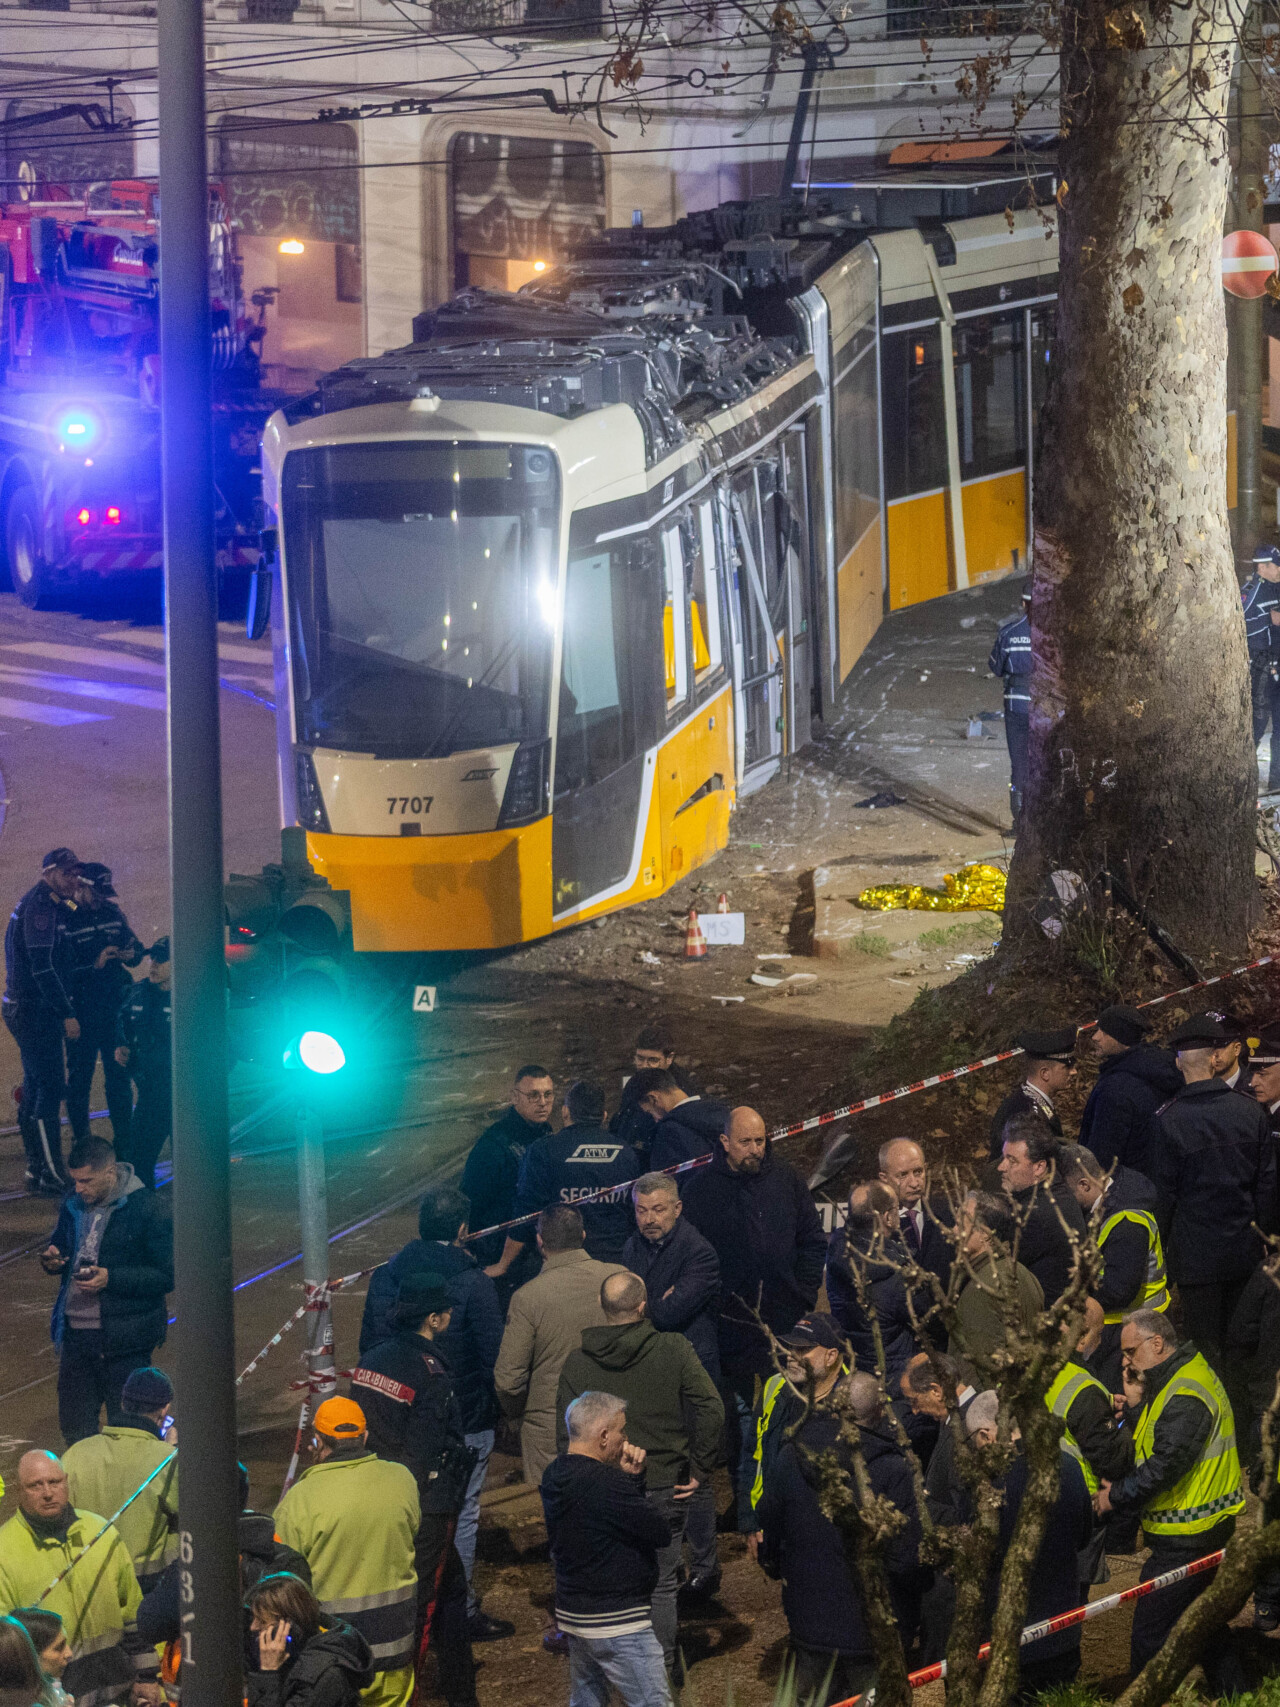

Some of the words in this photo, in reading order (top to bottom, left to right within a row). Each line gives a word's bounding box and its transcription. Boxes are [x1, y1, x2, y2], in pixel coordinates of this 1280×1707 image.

[387, 797, 434, 814] 7707
[417, 990, 431, 1006] A
[584, 1149, 608, 1158] ATM
[357, 1369, 401, 1396] CARABINIERI
